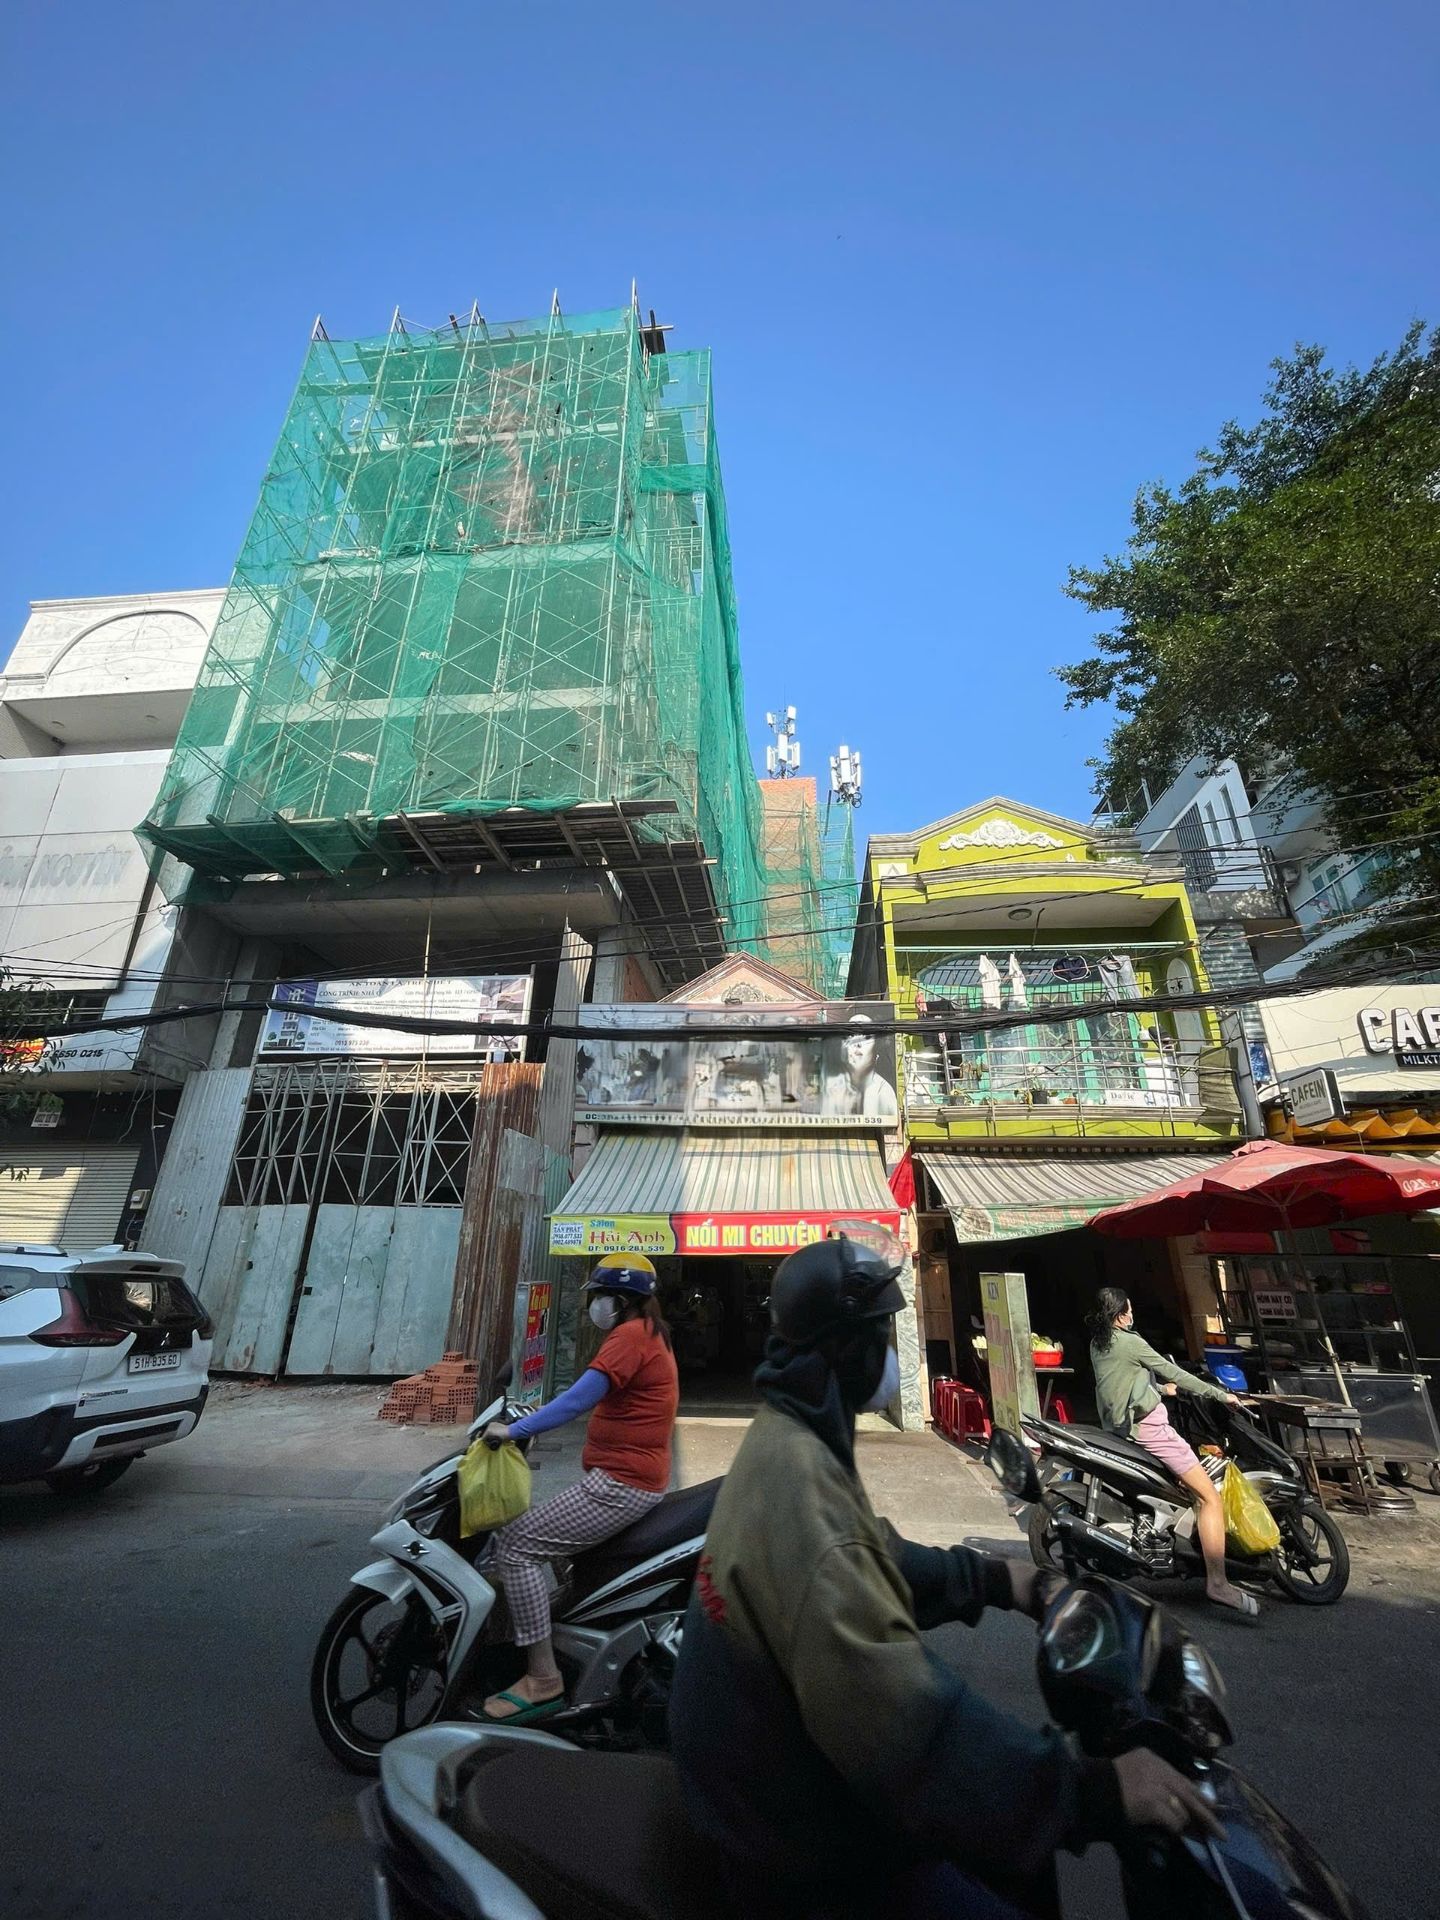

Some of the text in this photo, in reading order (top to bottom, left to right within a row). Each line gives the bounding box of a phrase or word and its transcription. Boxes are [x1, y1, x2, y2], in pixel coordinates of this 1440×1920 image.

[1402, 1054, 1440, 1065] MILKT
[1291, 1078, 1326, 1107] CAFEIN
[686, 1218, 719, 1247] NỐI
[722, 1225, 746, 1247] MI
